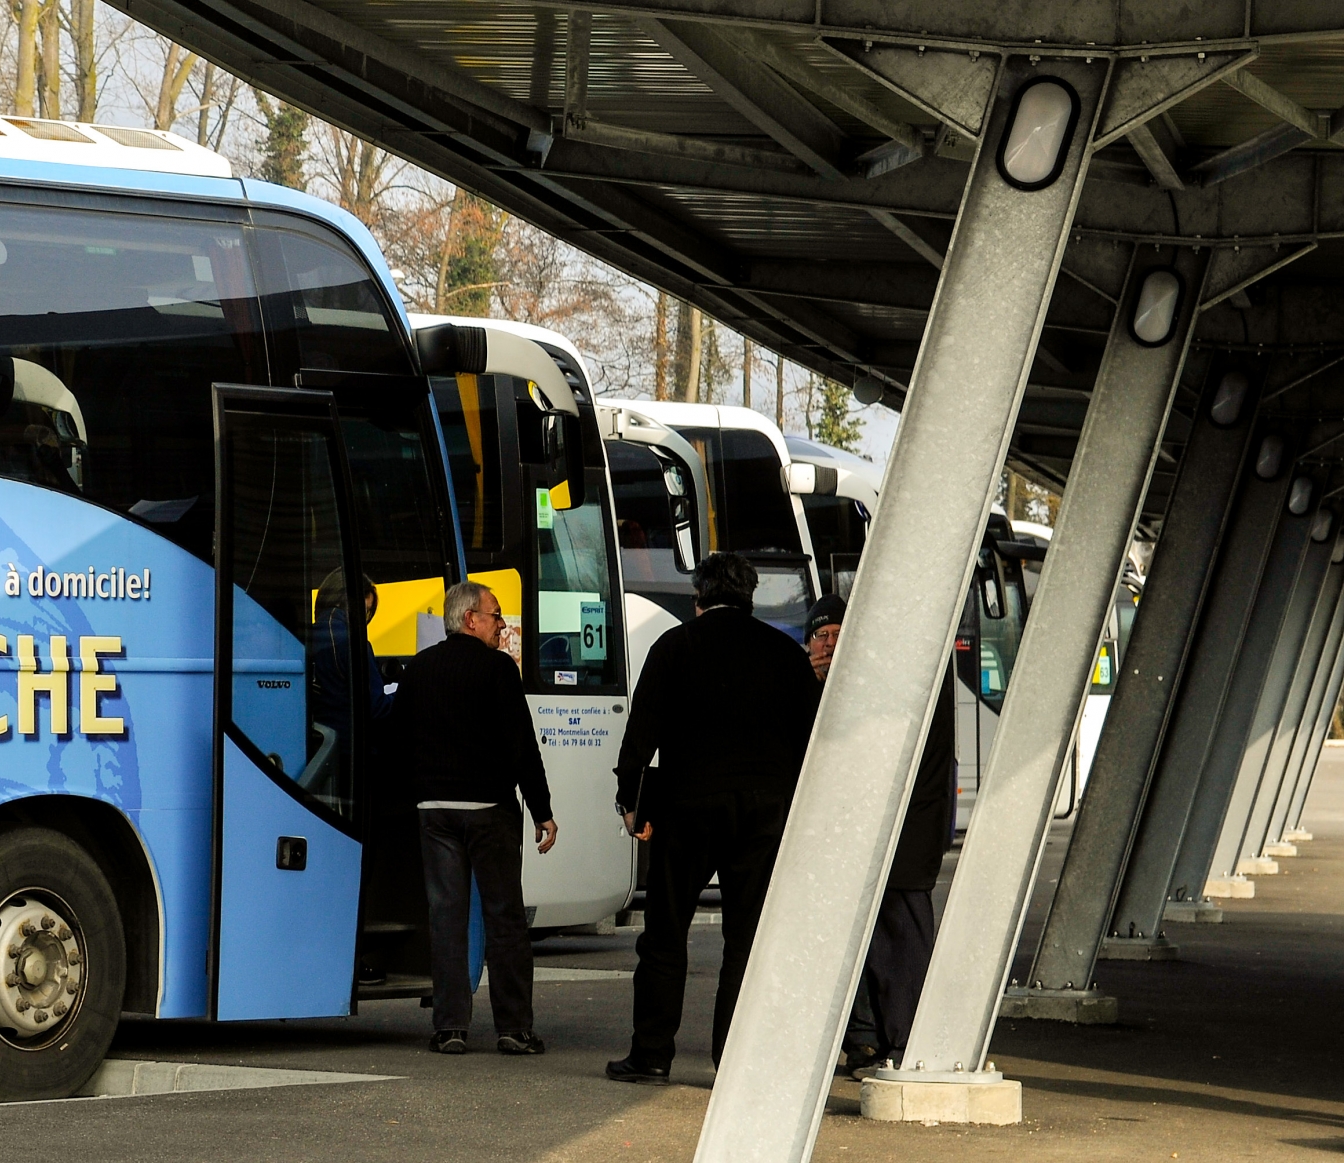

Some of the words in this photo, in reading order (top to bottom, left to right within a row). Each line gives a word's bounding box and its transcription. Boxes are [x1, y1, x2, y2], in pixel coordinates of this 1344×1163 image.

[4, 562, 20, 596] à
[28, 565, 151, 599] domicile!
[583, 623, 603, 649] 61
[257, 680, 291, 689] VOLVO
[537, 706, 554, 715] Cette
[555, 706, 569, 717] ligne
[570, 707, 580, 715] est
[581, 706, 601, 715] confiée
[602, 706, 606, 715] à
[568, 717, 581, 726] SAT
[540, 728, 556, 736] 73802
[557, 728, 590, 736] Montmelian
[591, 727, 609, 736] Cedex
[562, 738, 569, 747] 04
[571, 738, 578, 747] 79
